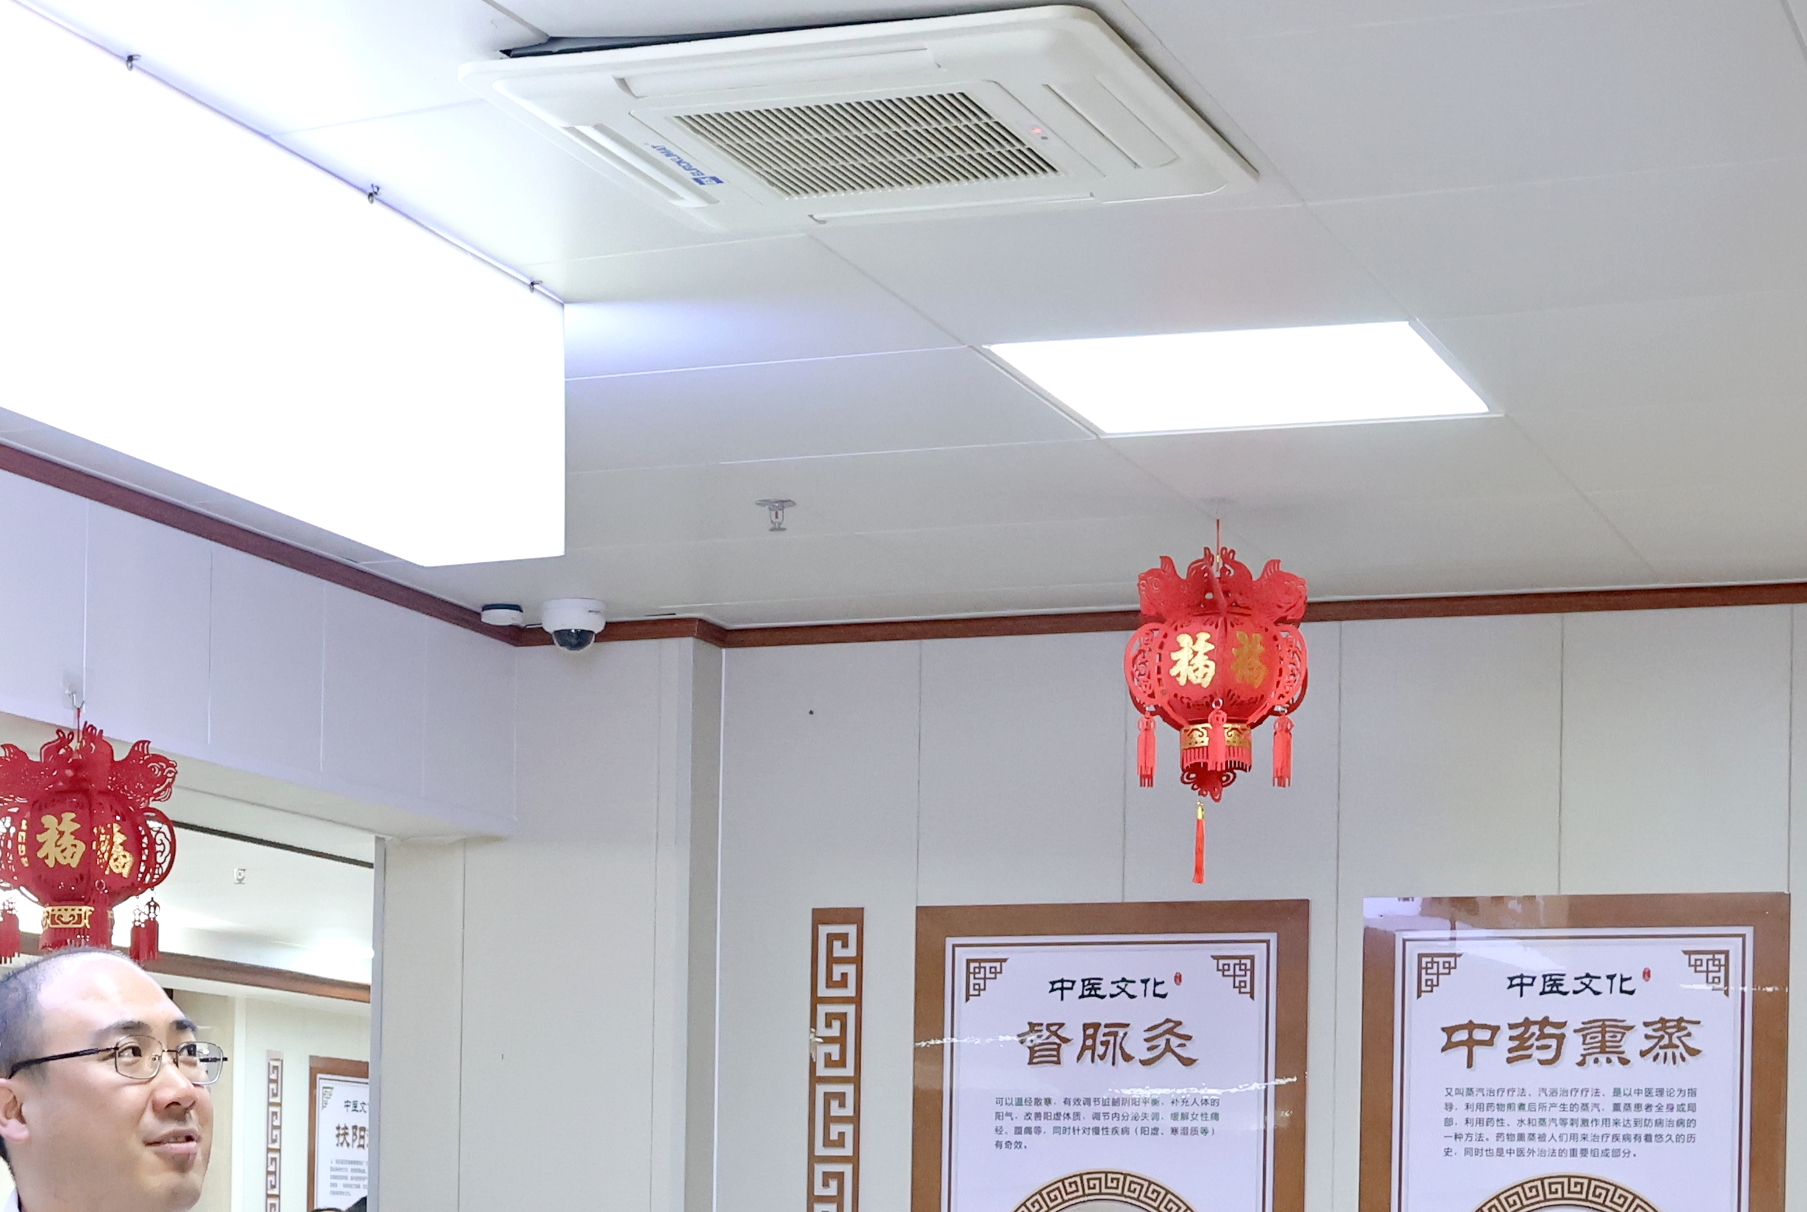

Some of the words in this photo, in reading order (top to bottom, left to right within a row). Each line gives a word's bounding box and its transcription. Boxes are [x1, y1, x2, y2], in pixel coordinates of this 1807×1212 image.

[1170, 632, 1216, 688] 福
[36, 812, 86, 868] 福
[1048, 976, 1168, 1001] 中医文化
[1506, 972, 1636, 997] 中医文化
[1017, 1017, 1198, 1066] 督脉灸
[1440, 1015, 1703, 1068] 中药熏蒸
[994, 1140, 1028, 1150] 有奇效。
